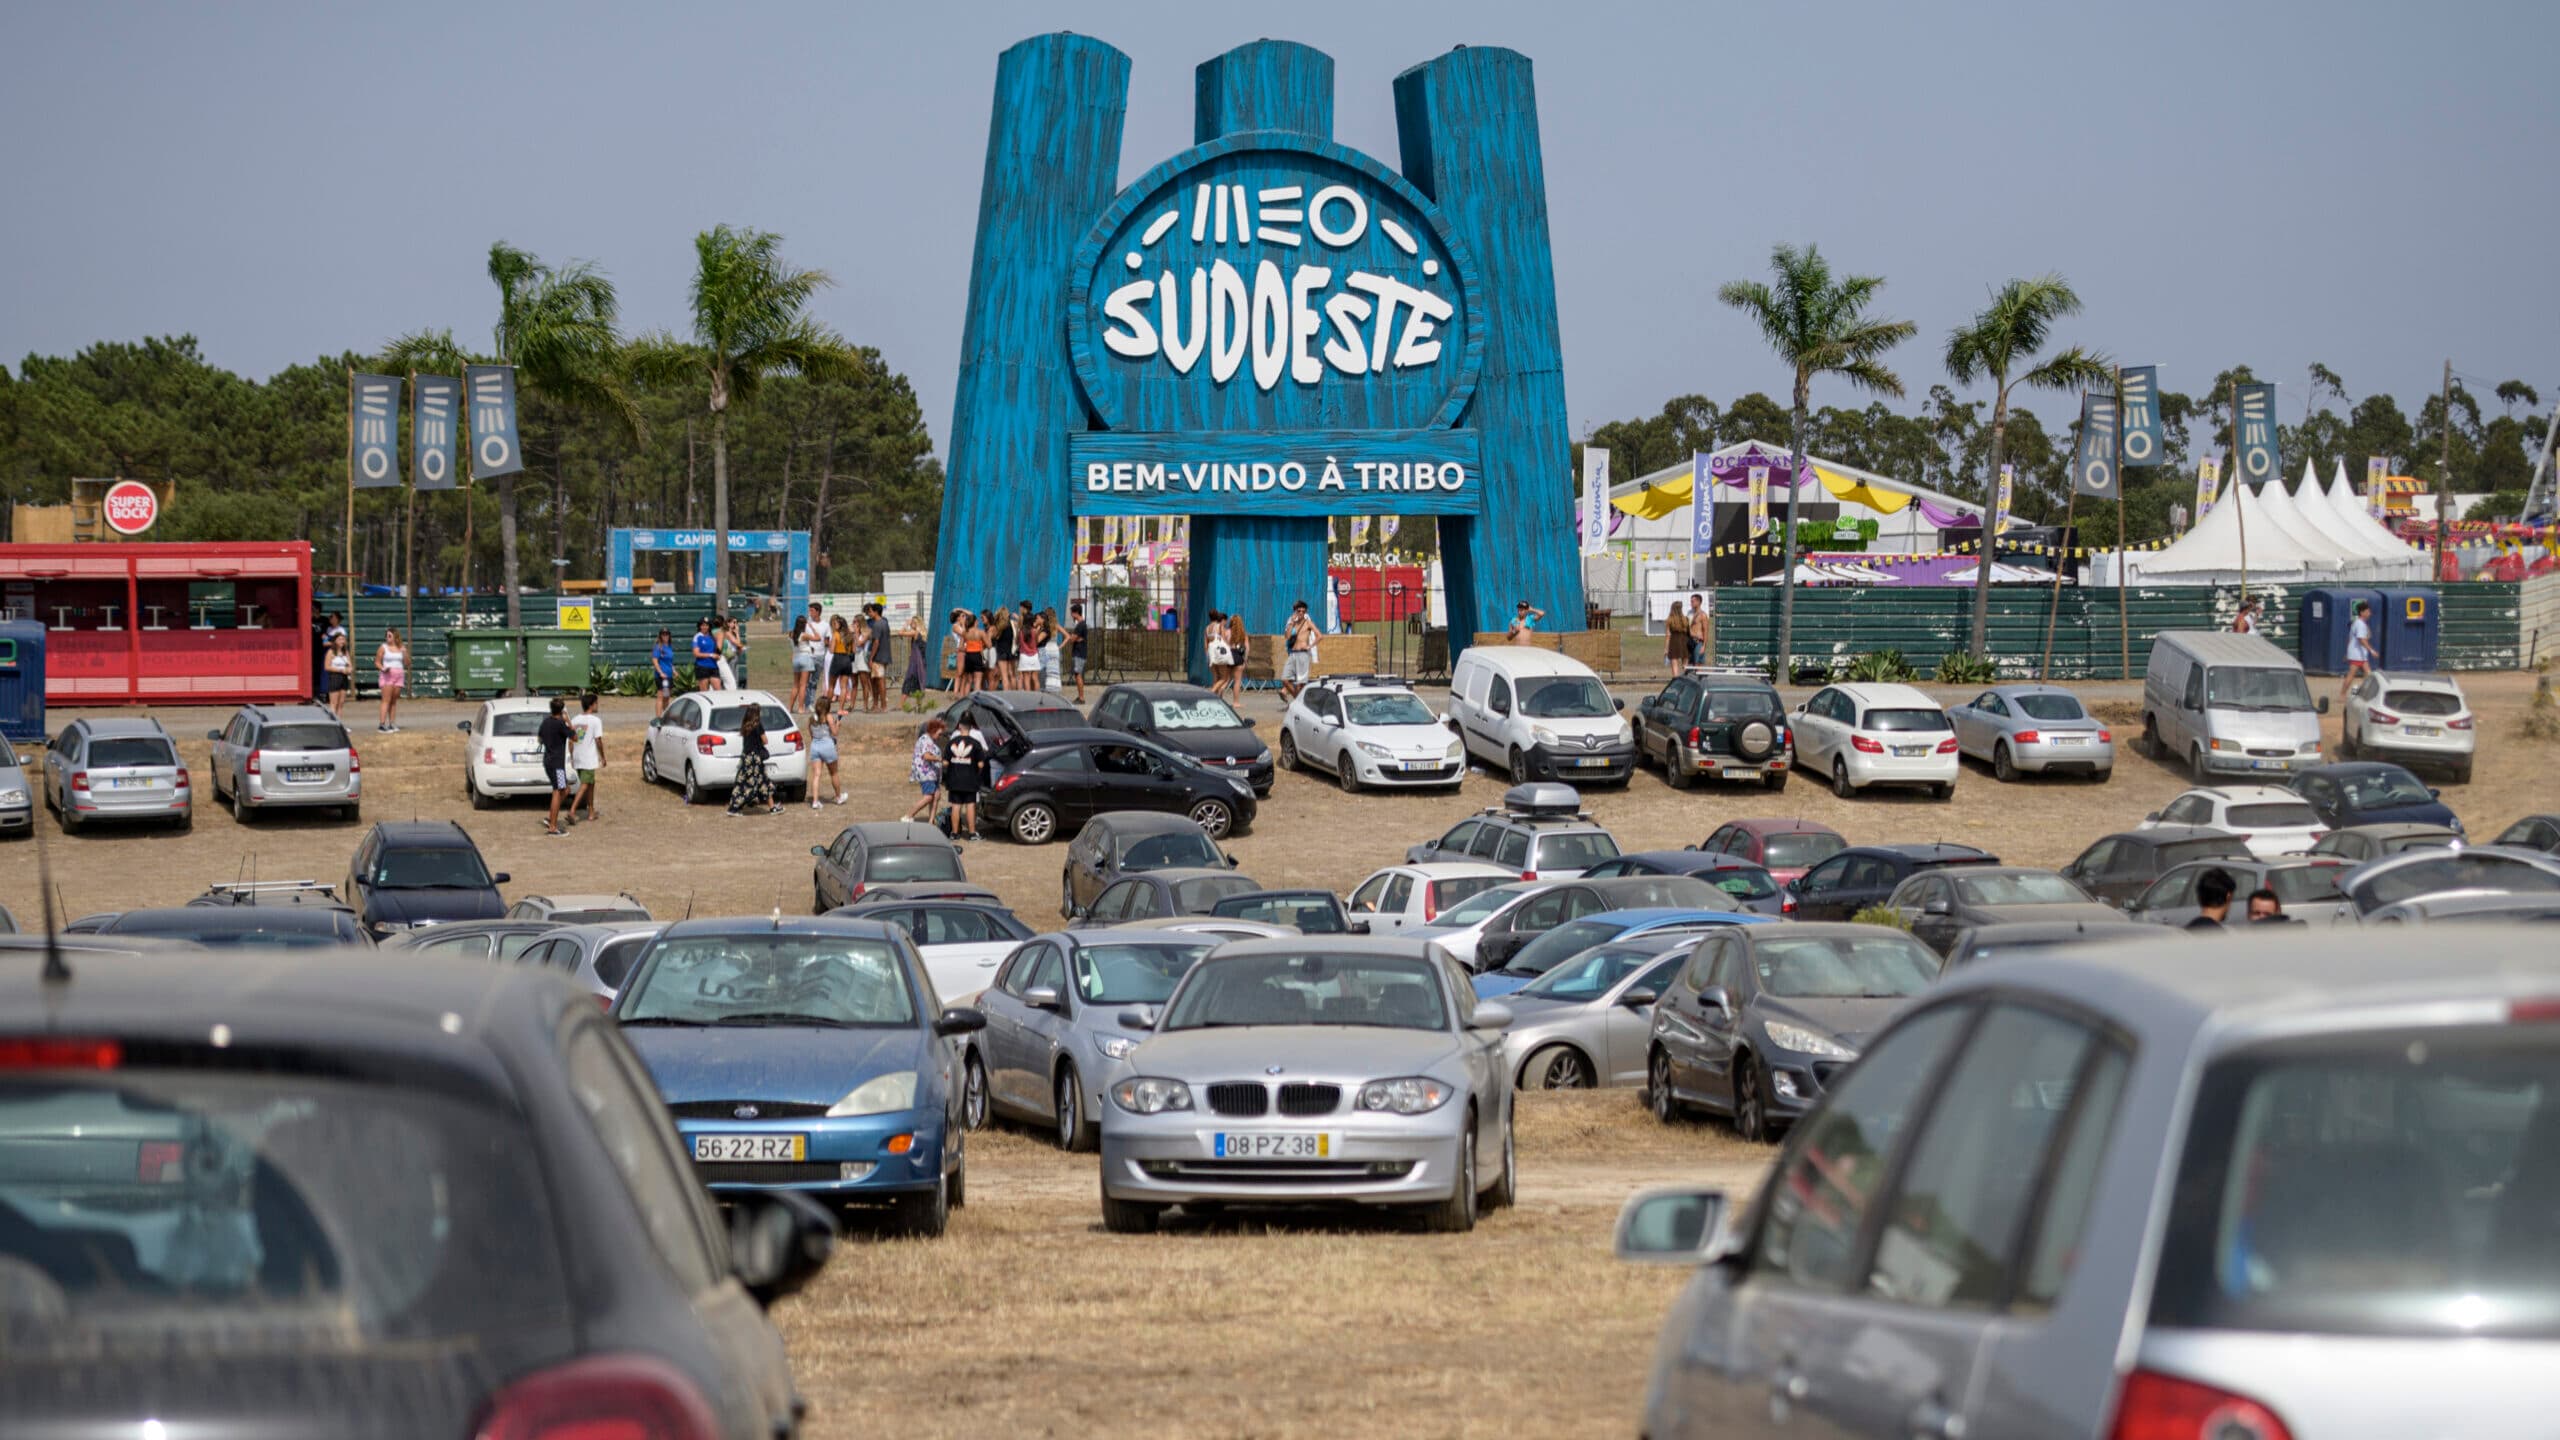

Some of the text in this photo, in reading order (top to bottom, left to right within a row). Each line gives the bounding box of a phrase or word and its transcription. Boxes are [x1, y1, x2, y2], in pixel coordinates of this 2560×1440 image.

[1191, 183, 1368, 246] MEO
[1103, 258, 1453, 390] SUDOESTE
[1087, 456, 1465, 491] BEM-VINDO À TRIBO
[110, 496, 151, 507] SUPER
[112, 507, 149, 519] BOCK
[675, 534, 747, 546] CAMPIMO
